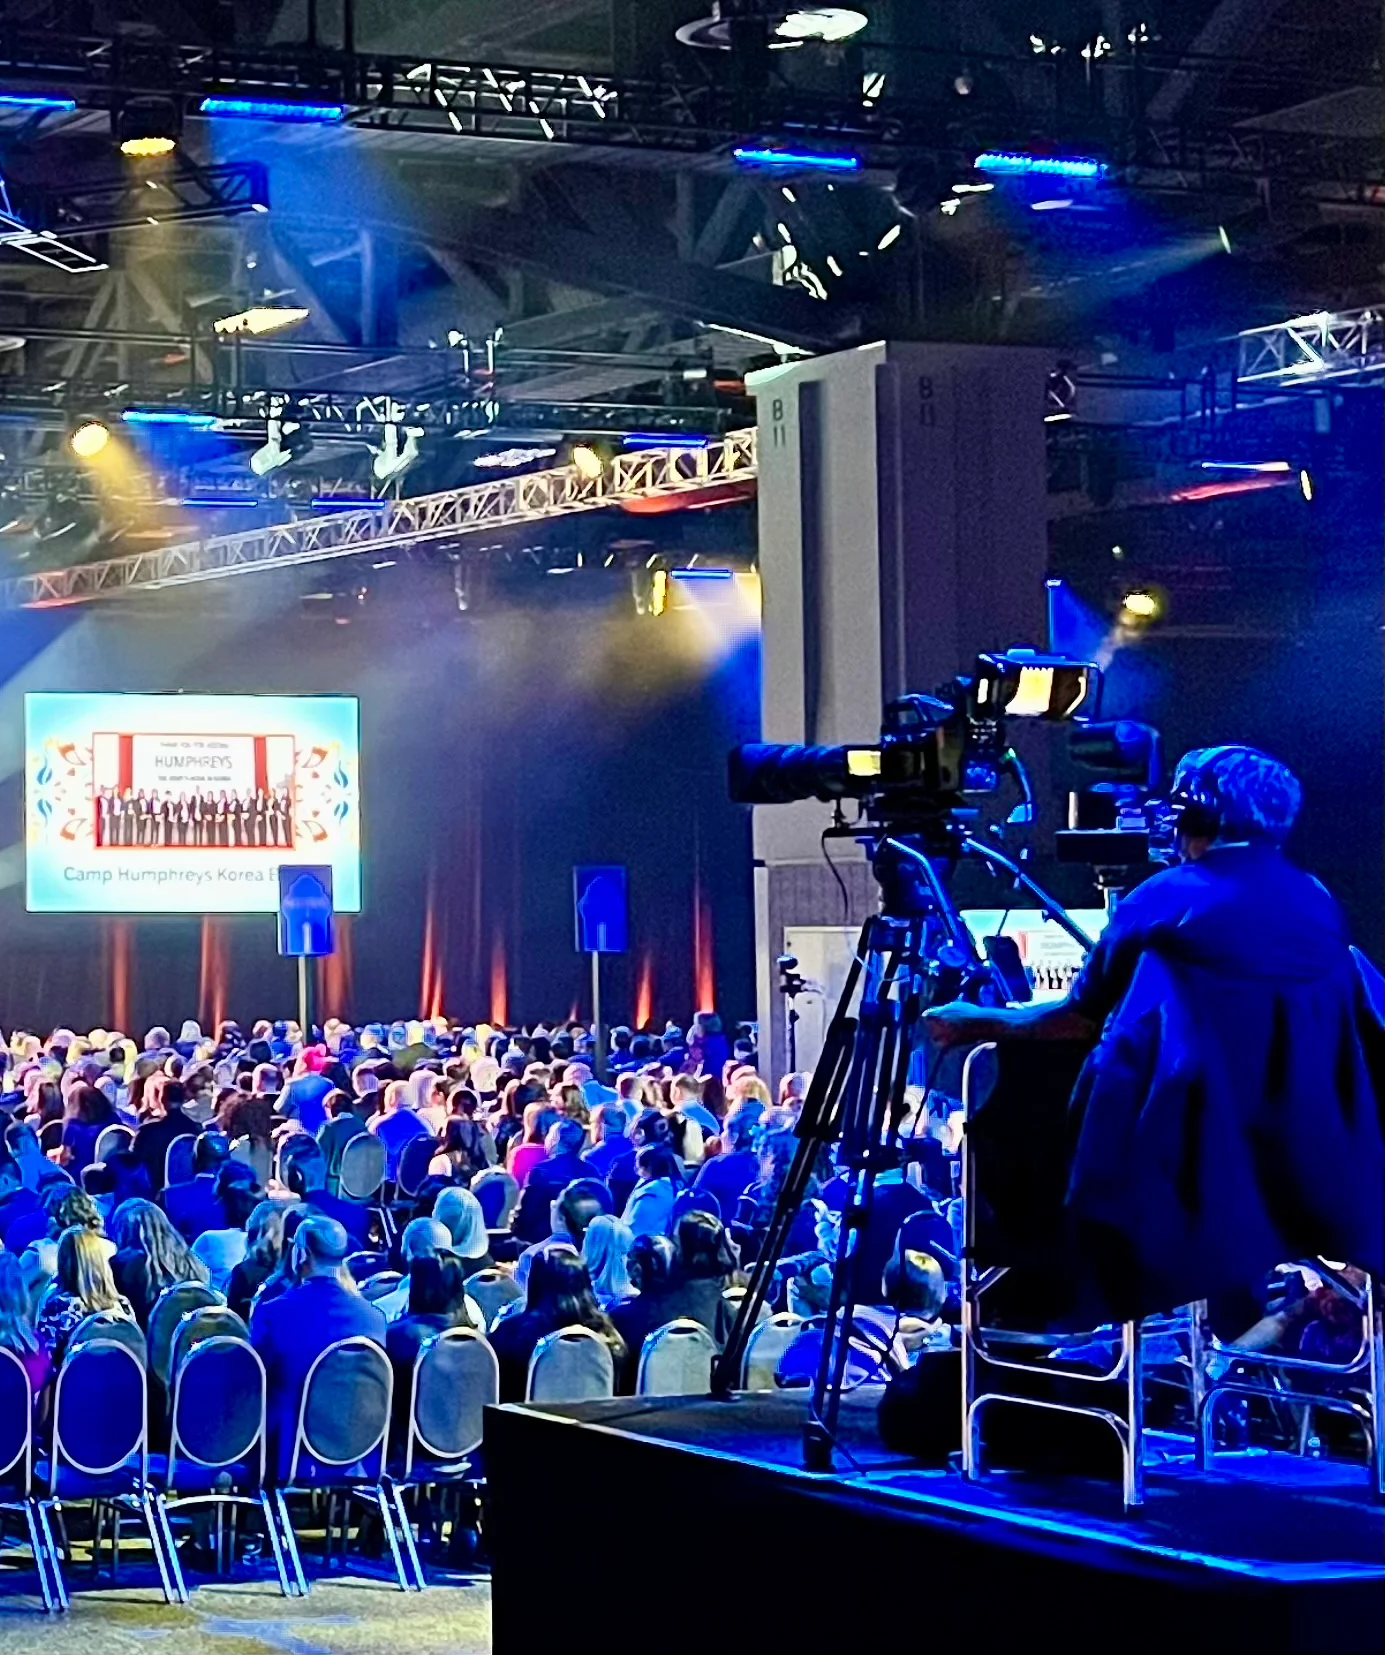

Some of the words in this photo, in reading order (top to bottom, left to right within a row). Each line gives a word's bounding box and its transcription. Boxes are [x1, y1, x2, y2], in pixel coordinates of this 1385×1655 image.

[772, 399, 784, 421] B
[773, 425, 786, 446] 11
[155, 755, 233, 769] HUMPHREYS
[63, 866, 113, 884] Camp
[118, 867, 212, 886] Humphreys
[217, 868, 264, 882] Korea
